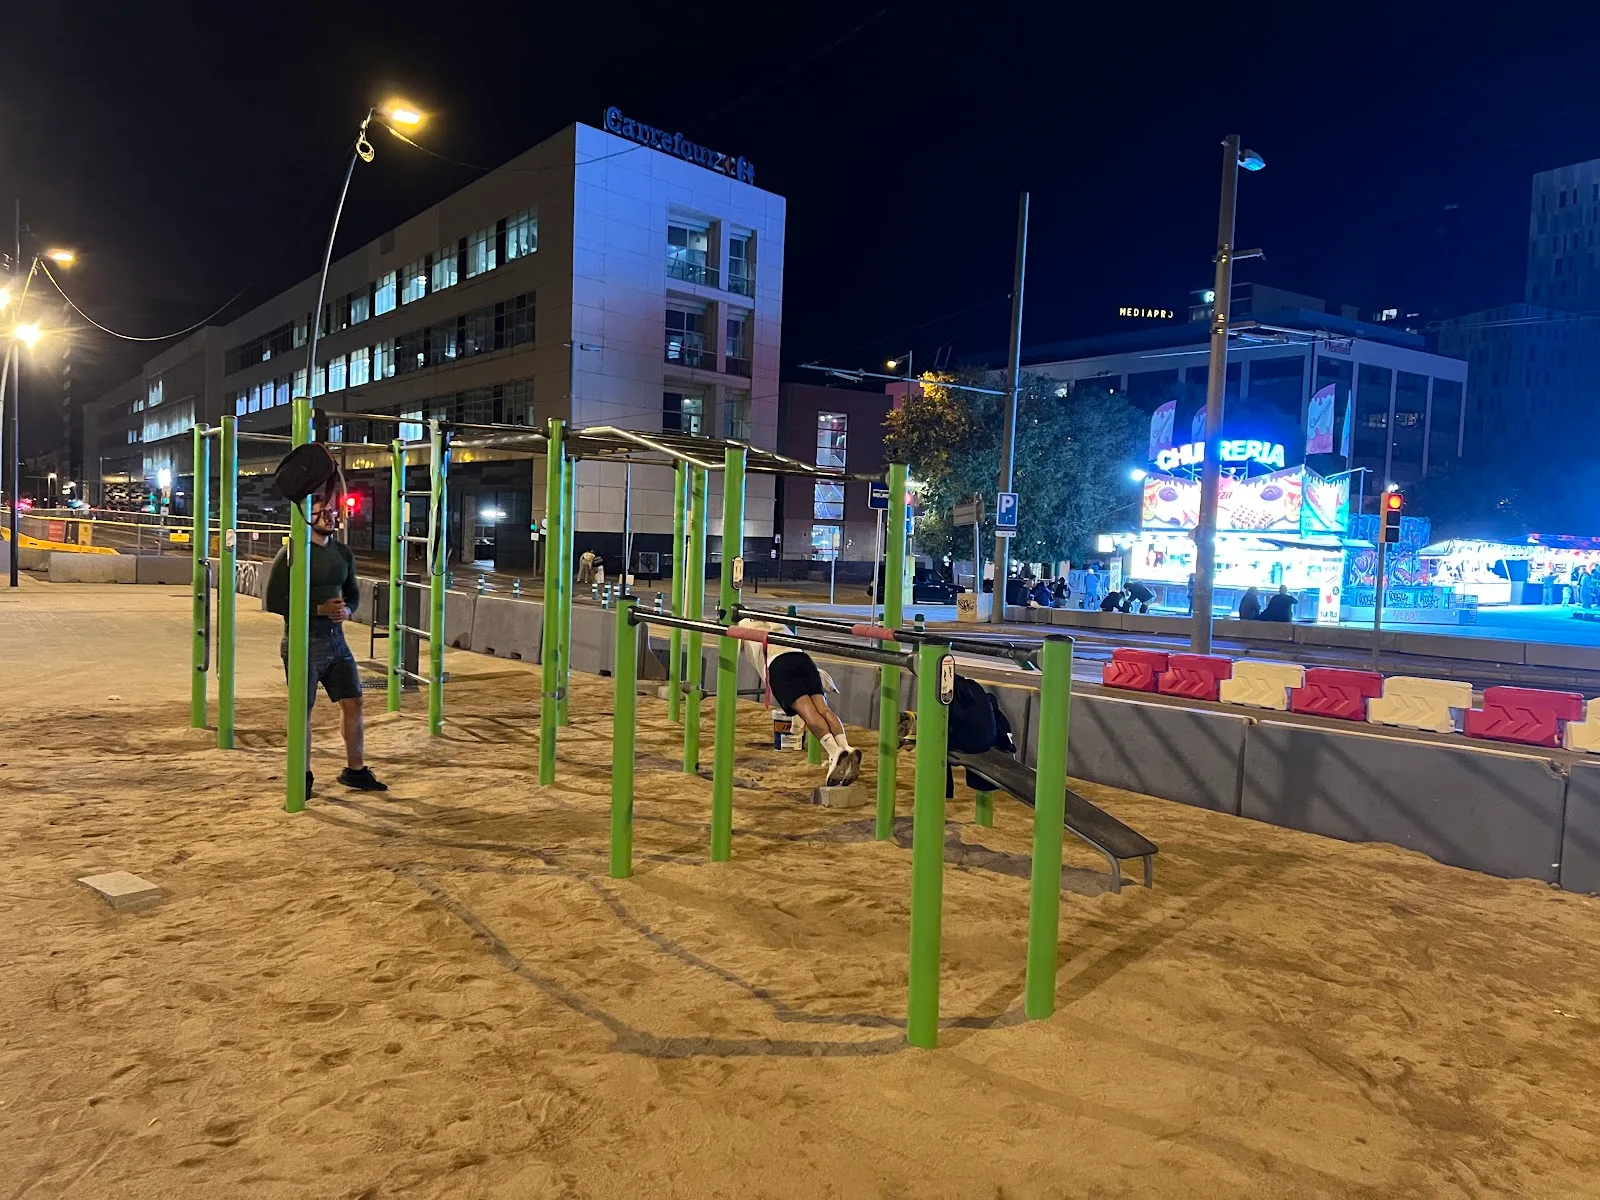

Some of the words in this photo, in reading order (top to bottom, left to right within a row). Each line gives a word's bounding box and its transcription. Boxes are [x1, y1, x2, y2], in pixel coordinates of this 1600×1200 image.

[606, 106, 718, 167] Carrefour
[1156, 440, 1285, 470] CHURERIA
[1001, 495, 1015, 514] P
